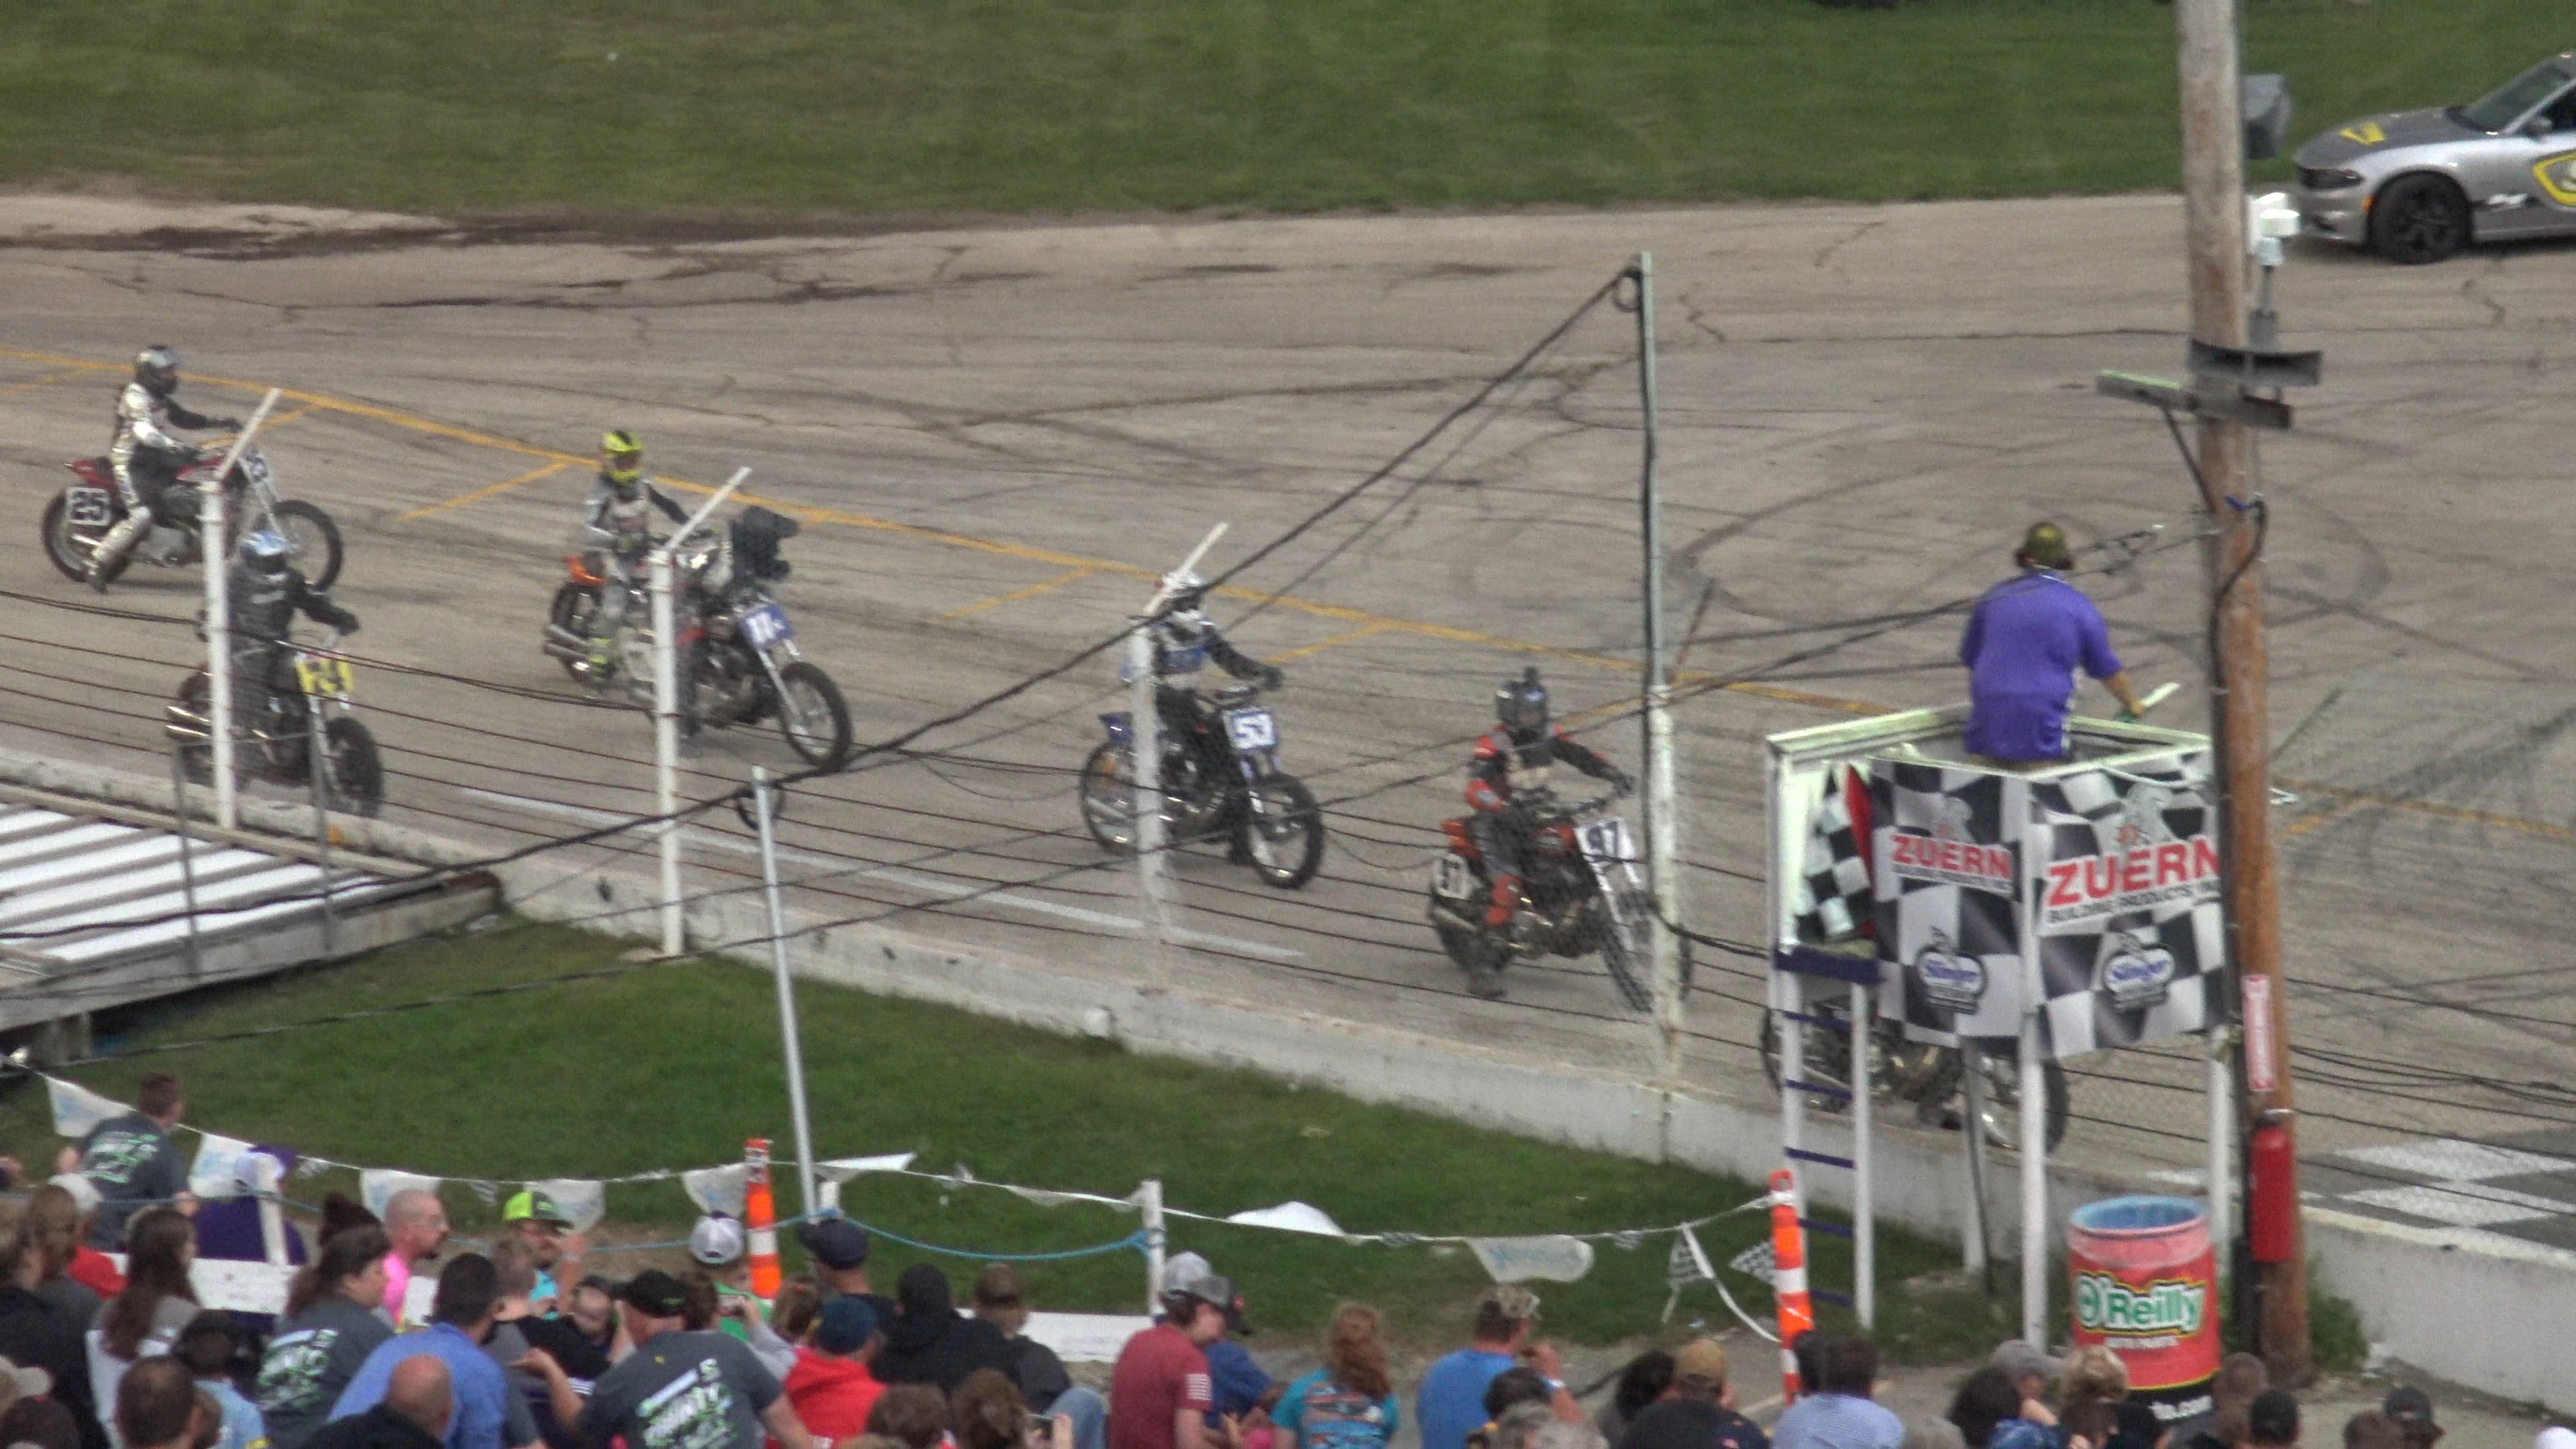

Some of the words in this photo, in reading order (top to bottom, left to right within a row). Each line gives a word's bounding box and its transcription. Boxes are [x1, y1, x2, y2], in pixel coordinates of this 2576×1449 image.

[1892, 835, 2011, 880] ZUERN
[2049, 839, 2220, 907] ZUERN
[2078, 1277, 2204, 1330] O'Reilly
